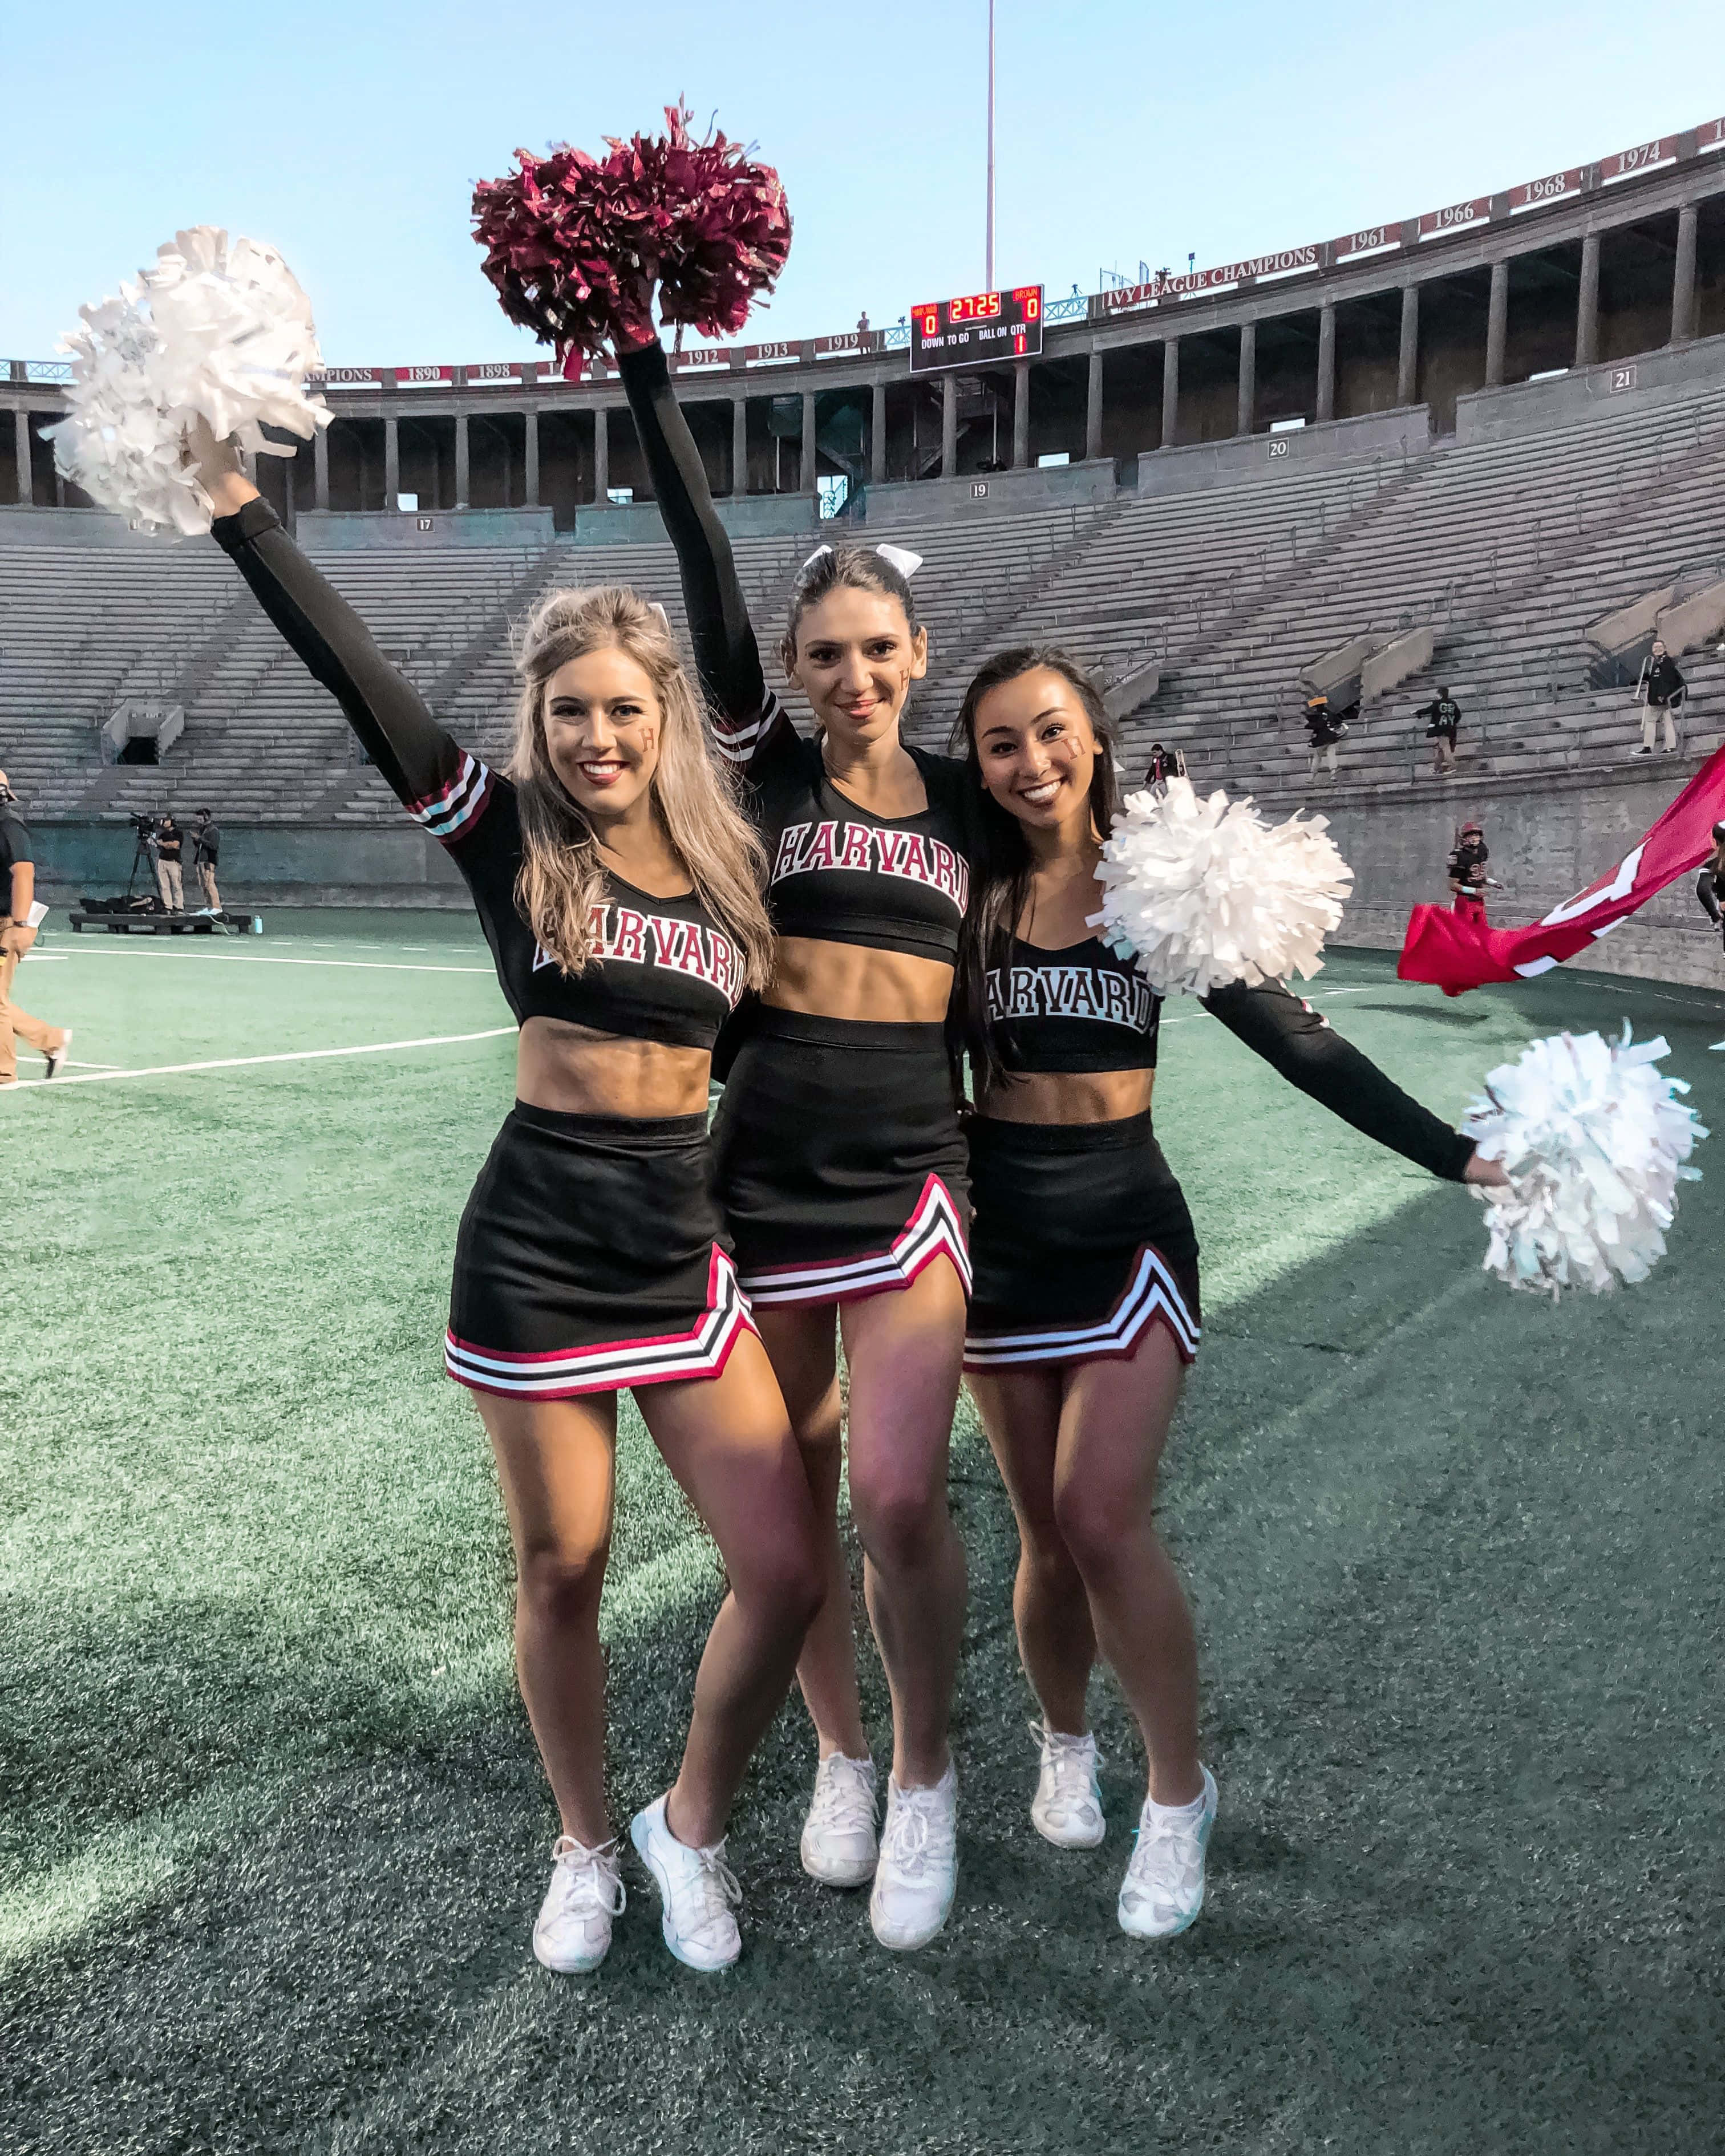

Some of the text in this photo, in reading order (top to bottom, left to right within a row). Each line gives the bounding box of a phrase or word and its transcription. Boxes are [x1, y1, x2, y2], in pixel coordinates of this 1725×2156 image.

[1617, 141, 1661, 173] 1974
[1523, 174, 1565, 202] 1968
[1435, 202, 1474, 229] 1966
[1350, 228, 1386, 252] 1961
[1107, 246, 1316, 307] IVY LEAGUE CHAMPIONS
[1027, 298, 1038, 318] 0
[925, 315, 936, 334] 0
[1010, 323, 1026, 335] QTR
[921, 333, 969, 350] DOWN TO GO
[979, 326, 1007, 341] BALL ON
[758, 342, 788, 358] 1913
[827, 334, 859, 351] 1919
[1019, 336, 1023, 352] 1
[688, 350, 719, 364] 1912
[303, 369, 372, 382] AMPIONS
[408, 367, 440, 381] 1890
[479, 364, 510, 378] 1898
[1615, 371, 1630, 387] 21
[1270, 442, 1286, 456] 20
[974, 484, 986, 497] 19
[420, 520, 431, 530] 17
[899, 667, 909, 691] H
[638, 728, 654, 753] H
[1061, 736, 1086, 760] H
[771, 821, 970, 918] HARVARD
[985, 966, 1154, 1034] ARVARD
